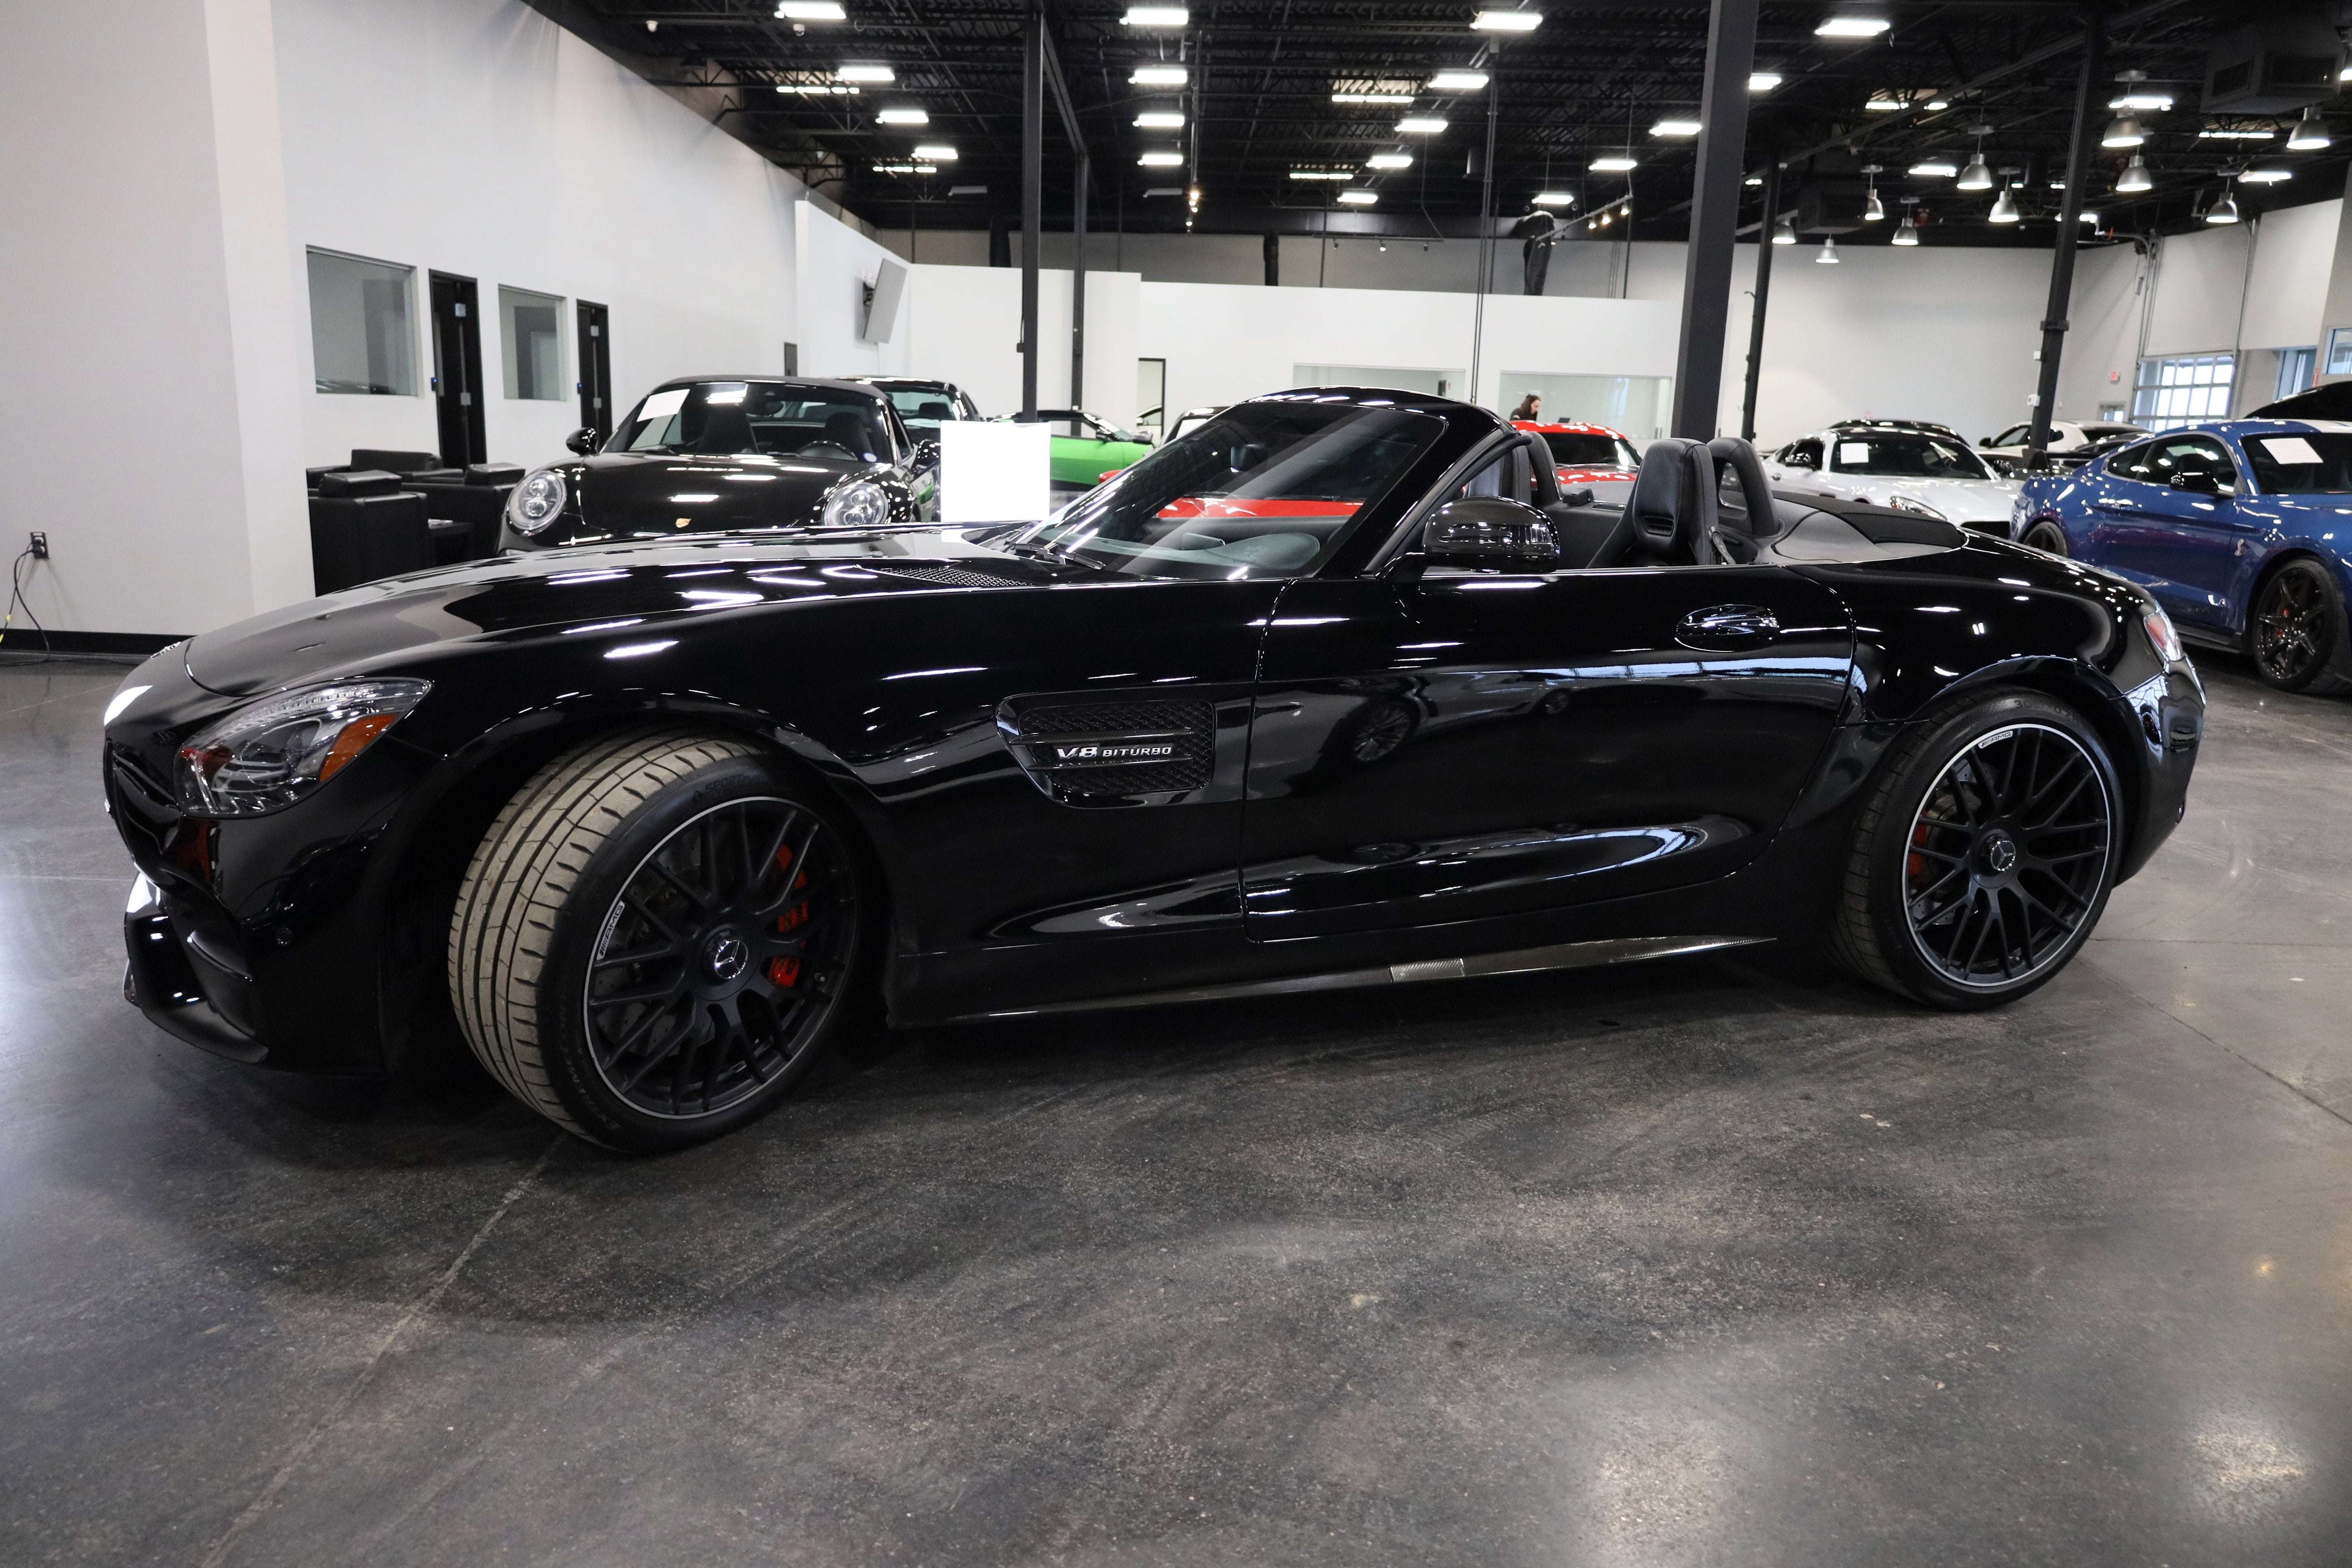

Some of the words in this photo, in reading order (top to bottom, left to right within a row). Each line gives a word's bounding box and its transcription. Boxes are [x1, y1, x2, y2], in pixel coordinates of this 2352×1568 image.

[1991, 732, 2011, 742] AMG
[1056, 746, 1097, 759] V8
[1102, 747, 1172, 757] BITURBO
[605, 904, 624, 941] AMG
